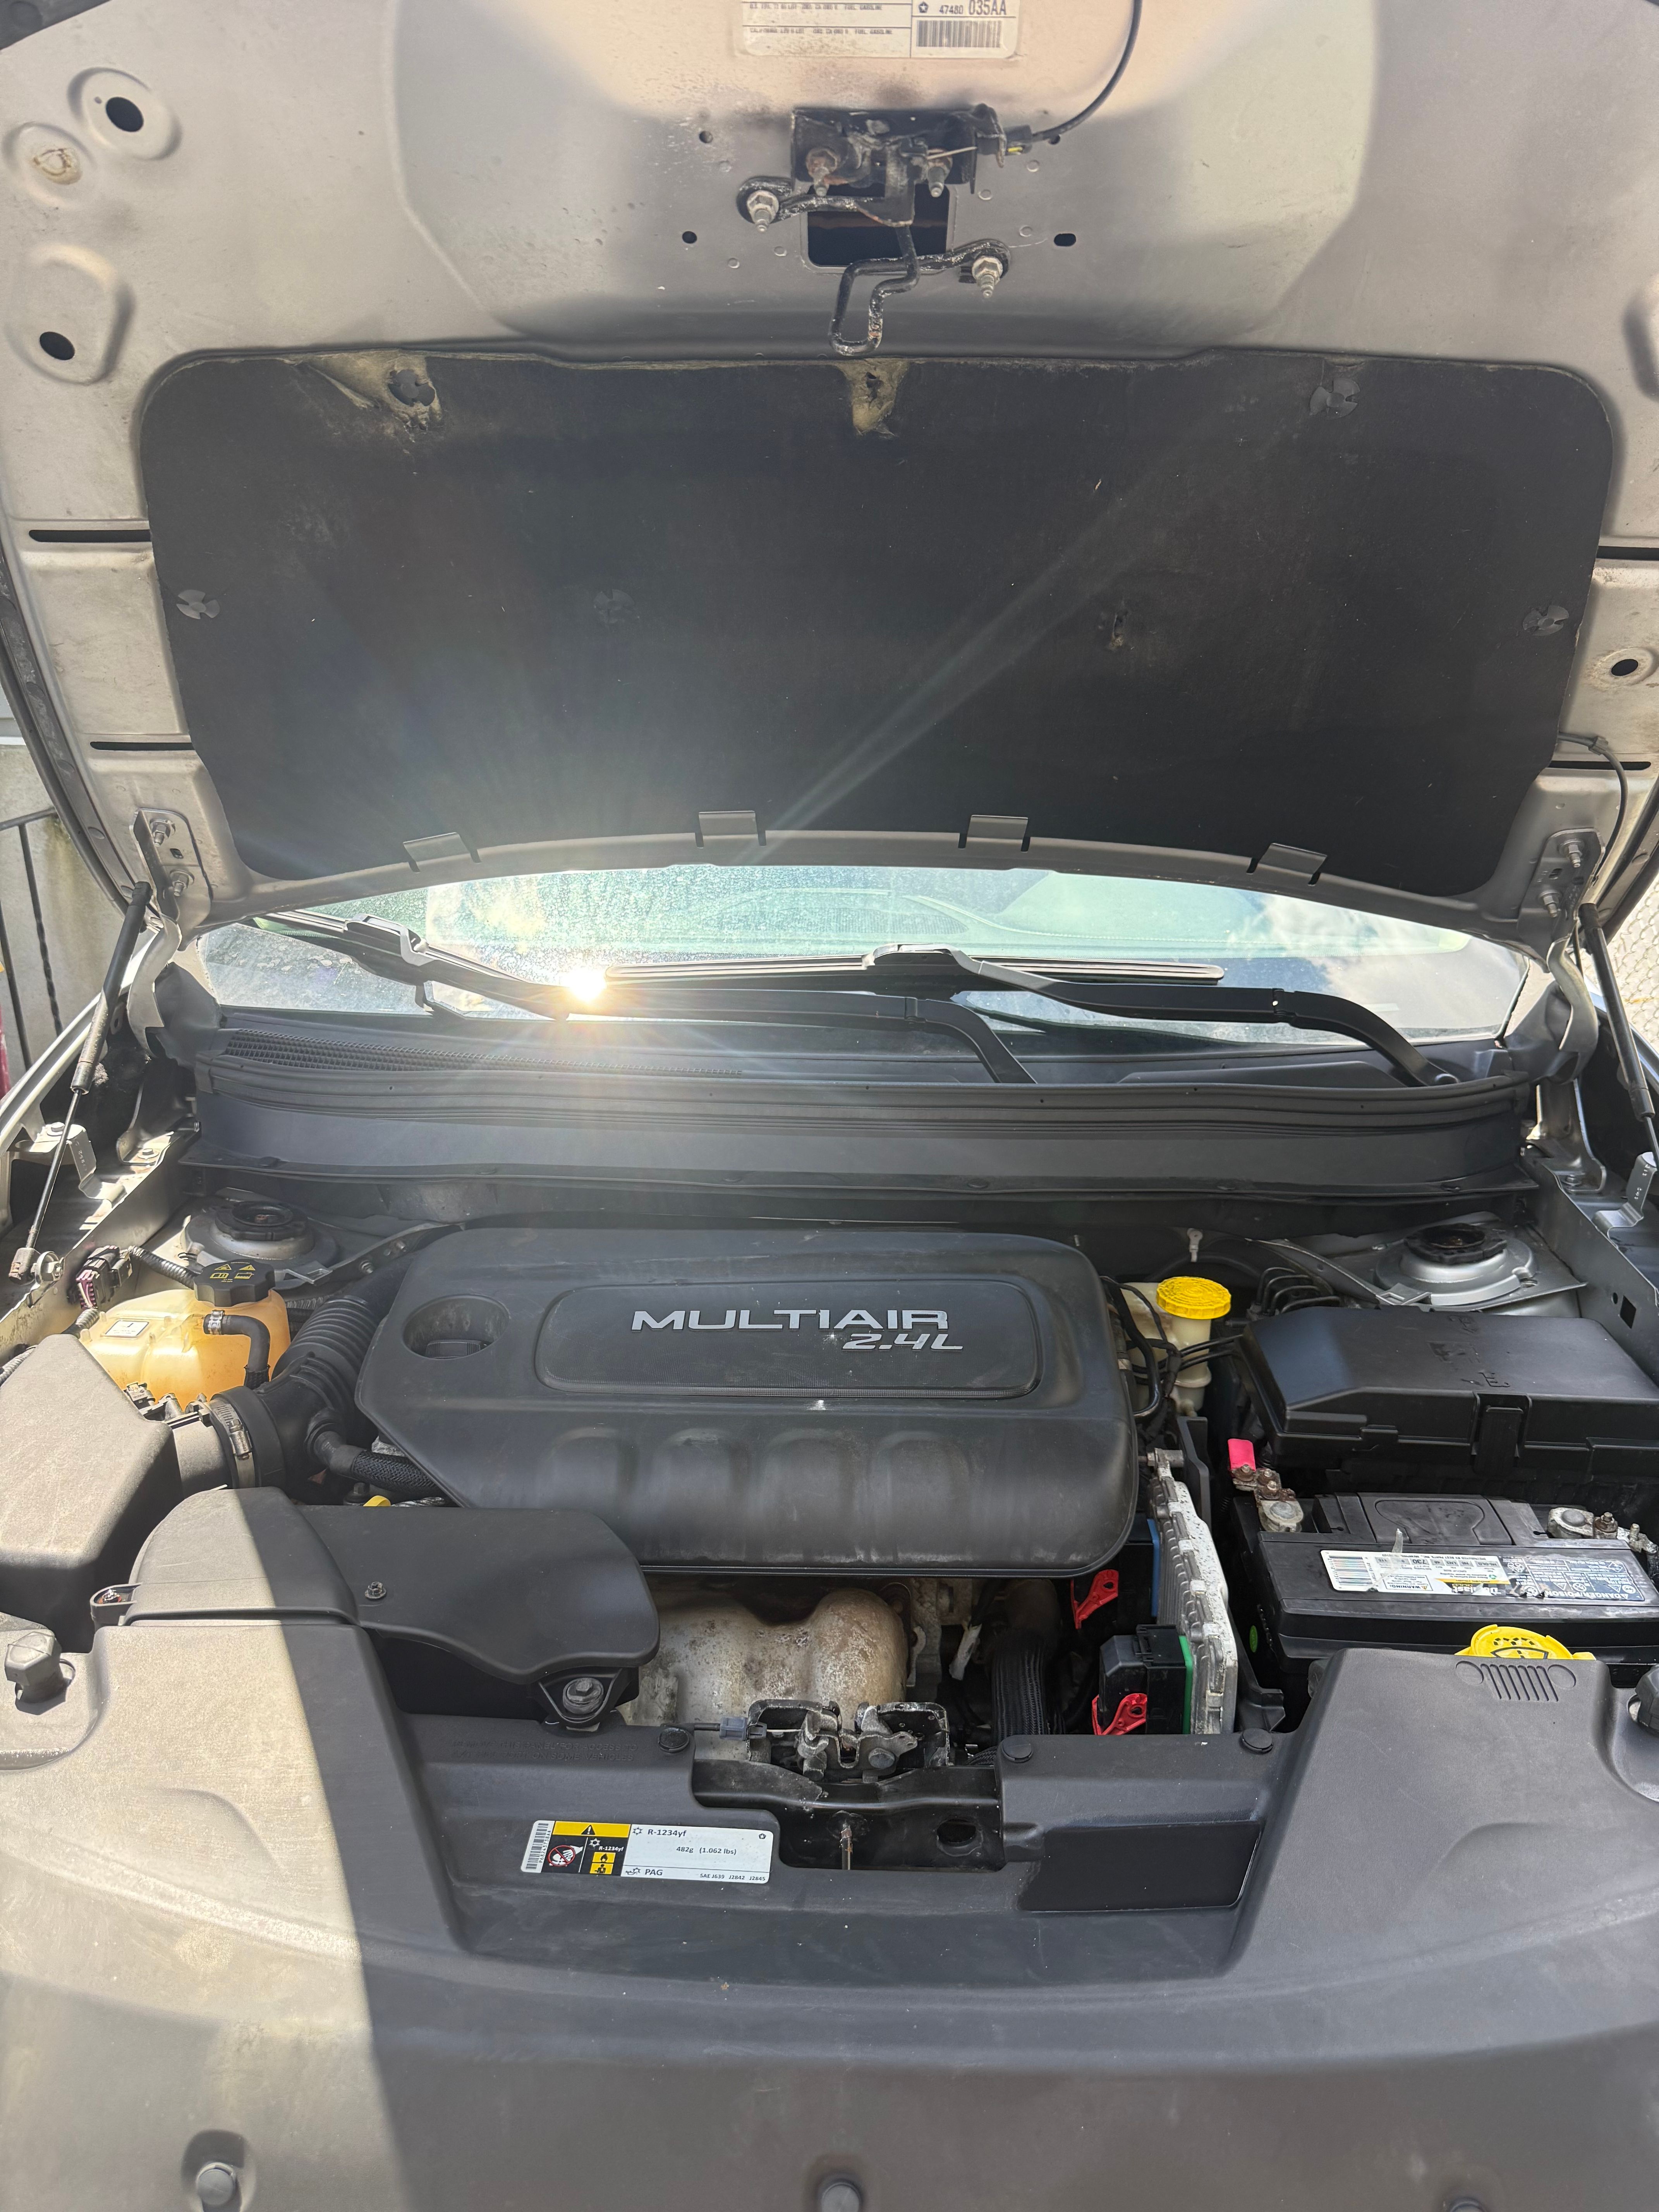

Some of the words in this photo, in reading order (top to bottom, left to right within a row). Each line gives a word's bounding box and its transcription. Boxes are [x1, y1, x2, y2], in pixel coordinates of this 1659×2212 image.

[969, 0, 1006, 15] 035AA
[631, 1310, 948, 1330] MULTIAIR
[842, 1334, 963, 1350] 2.4L
[586, 1753, 634, 1761] VEHICLES
[647, 1829, 687, 1838] R-1234yf
